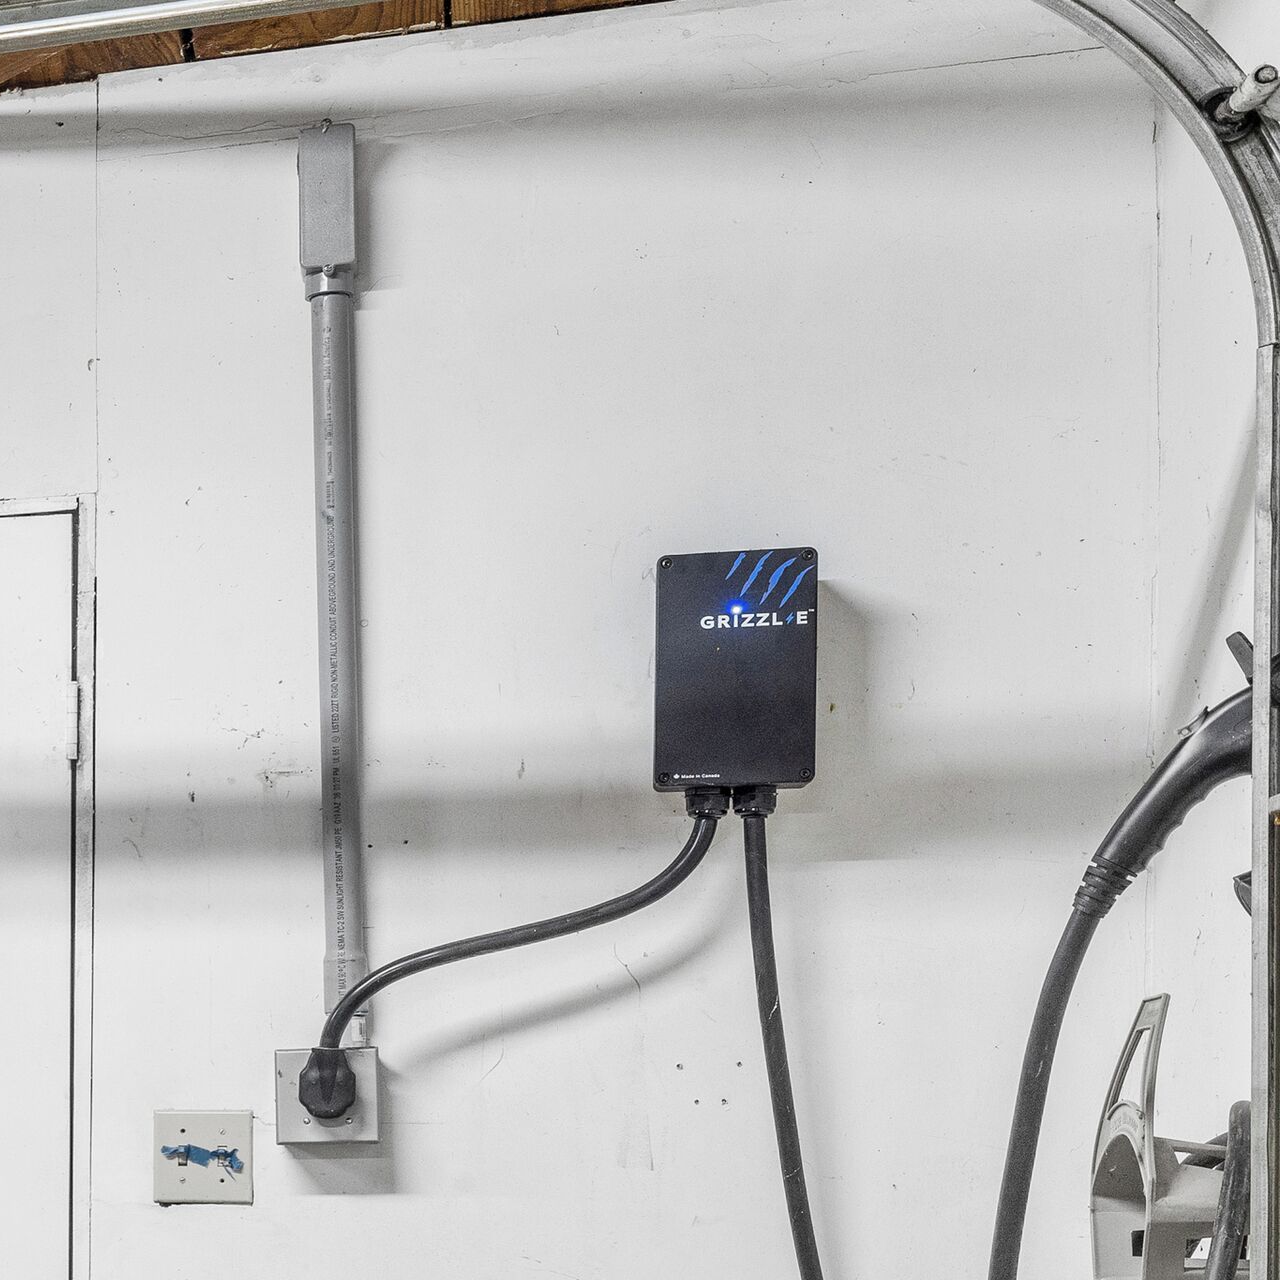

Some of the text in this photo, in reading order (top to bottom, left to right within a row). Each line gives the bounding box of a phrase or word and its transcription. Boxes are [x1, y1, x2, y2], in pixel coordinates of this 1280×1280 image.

[326, 516, 336, 559] UNDERGROUND
[327, 560, 336, 572] AND
[328, 572, 336, 616] ABOVEGROUND
[328, 617, 337, 641] CONDUIT
[330, 641, 338, 682] NON-METALLIC
[330, 683, 338, 699] RIGID
[331, 713, 339, 733] LISTED
[334, 850, 343, 882] RESISTANT
[336, 883, 344, 910] SUNLIGHT
[337, 934, 345, 951] NEMA
